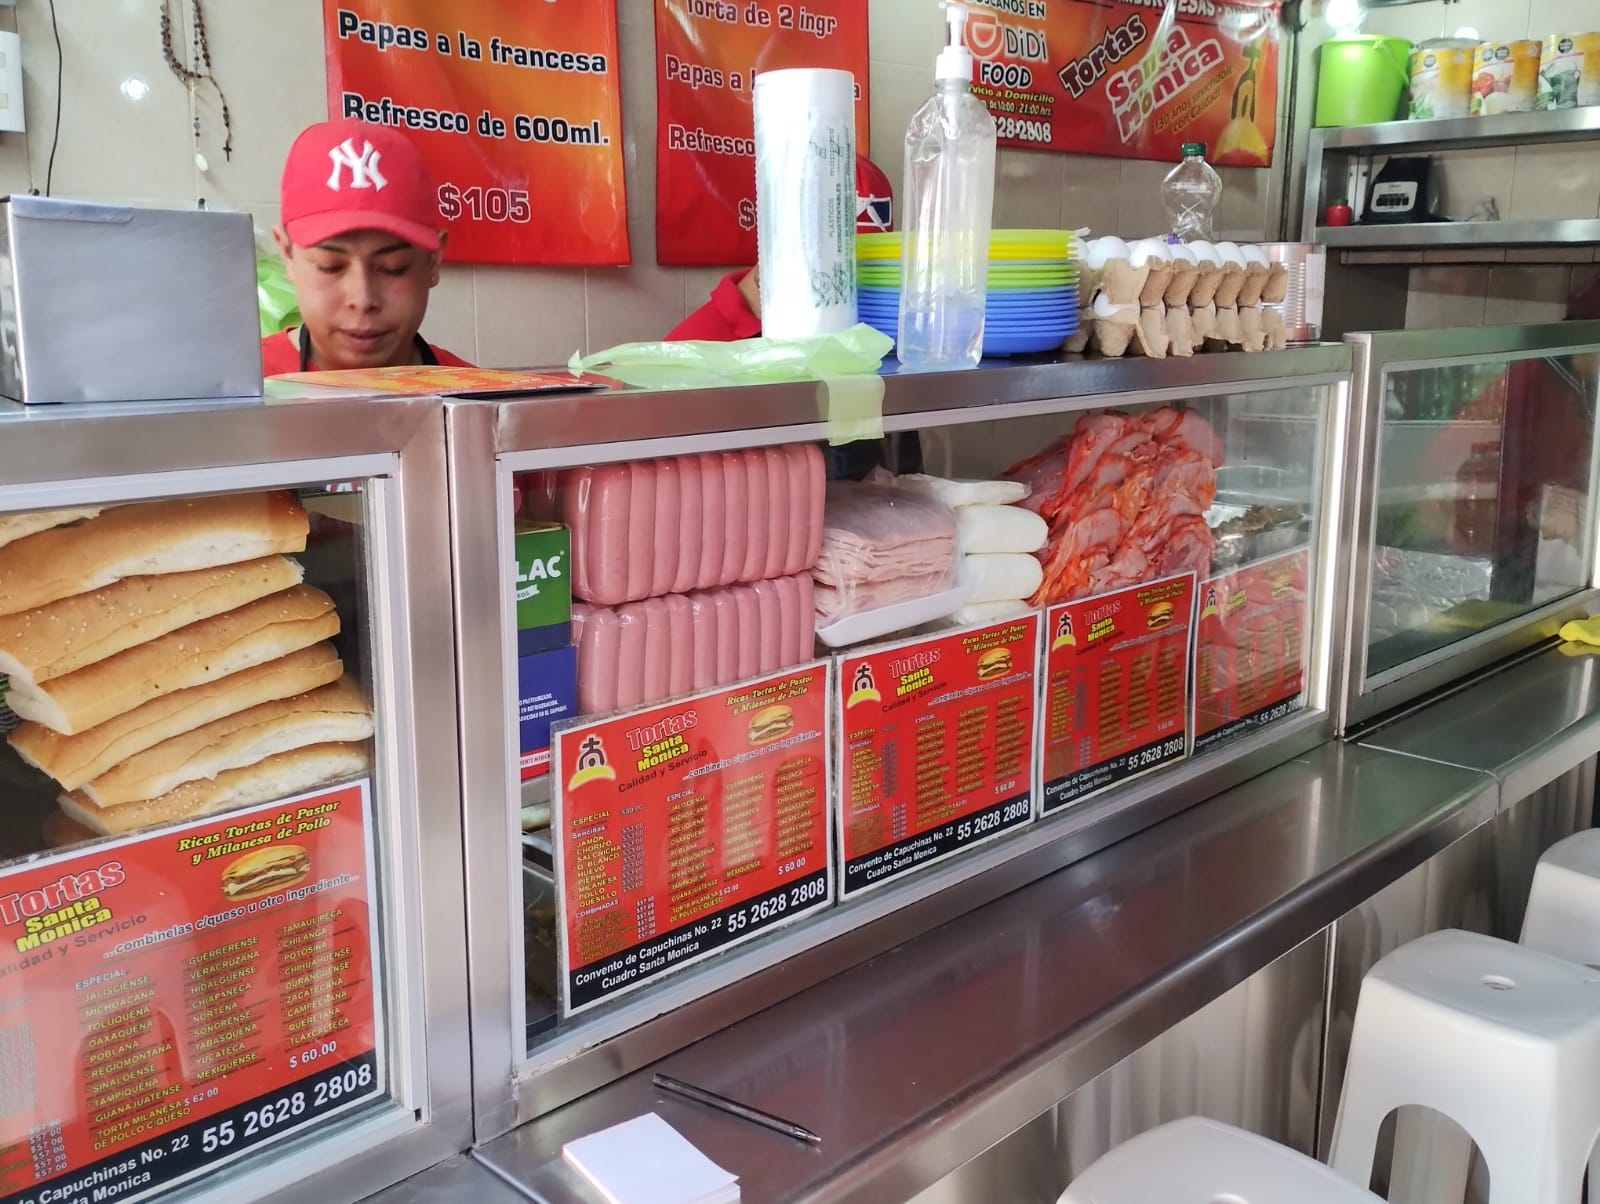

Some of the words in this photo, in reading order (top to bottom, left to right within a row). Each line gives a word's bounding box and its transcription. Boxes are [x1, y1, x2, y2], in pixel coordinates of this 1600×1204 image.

[744, 2, 771, 25] de
[778, 6, 794, 29] 2
[799, 7, 837, 39] ingr
[1028, 2, 1046, 18] EN
[338, 10, 428, 51] Papas
[437, 33, 451, 55] a
[459, 32, 481, 61] la
[490, 38, 607, 73] francesa
[1005, 27, 1048, 63] DiDi
[1058, 14, 1147, 99] Tortas
[665, 54, 723, 90] Papas
[730, 71, 742, 90] a
[981, 62, 1032, 88] FOOD
[1005, 89, 1055, 103] Domicilio
[1019, 103, 1039, 115] 21:00
[343, 92, 469, 133] Refresco
[477, 110, 506, 138] de
[514, 116, 610, 146] 600ml.
[669, 124, 756, 157] Refresco
[326, 137, 389, 192] NY
[438, 183, 531, 223] $105
[1090, 618, 1113, 633] Santa
[888, 647, 941, 678] Tortas
[900, 666, 930, 685] Santa
[727, 692, 752, 707] Ricas
[752, 685, 778, 699] Tortas
[779, 681, 788, 691] de
[778, 693, 787, 703] de
[788, 685, 808, 700] Pollo
[896, 674, 934, 697] Monica
[626, 709, 698, 751] Tortas
[637, 743, 689, 773] Monica
[642, 734, 683, 758] Santa
[1127, 756, 1139, 771] 55
[1141, 745, 1162, 766] 2628
[1164, 737, 1184, 756] 2808
[618, 770, 658, 793] Calidad
[660, 766, 667, 778] y
[668, 748, 708, 773] Servicio
[667, 788, 695, 802] ESPECIAL
[176, 829, 220, 853] Ricas
[224, 816, 273, 839] Tortas
[275, 811, 292, 826] de
[296, 799, 340, 821] Pastor
[572, 811, 611, 826] ESPECIAL
[572, 824, 606, 839] Sencillas
[191, 850, 202, 867] y
[205, 831, 272, 860] Milanesa
[275, 825, 292, 841] de
[295, 814, 331, 835] Pollo
[577, 840, 612, 855] CHORIZO
[848, 855, 883, 875] Convento
[884, 851, 893, 861] de
[893, 836, 933, 858] Capuchinas
[934, 830, 945, 843] No.
[946, 826, 954, 839] 22
[957, 822, 972, 841] 55
[974, 809, 1001, 833] 2628
[1003, 799, 1029, 823] 2808
[577, 846, 621, 863] SALCHICHA
[778, 866, 784, 876] $
[784, 857, 806, 872] 60.00
[866, 862, 892, 880] Cuadro
[893, 855, 912, 870] Santa
[913, 846, 937, 865] Monica
[577, 865, 605, 878] HUEVO
[579, 876, 618, 892] MILANESA
[0, 861, 126, 925] Tortas
[579, 887, 605, 900] POLLO
[579, 891, 617, 908] QUESILLO
[25, 897, 101, 933] Santa
[196, 906, 246, 930] c/queso
[248, 902, 256, 913] u
[259, 893, 284, 911] otro
[283, 909, 342, 932] TAMAULIPECA
[576, 899, 619, 919] COMBINADAS
[15, 908, 112, 953] Monica
[58, 943, 68, 957] y
[75, 911, 147, 948] Servicio
[283, 927, 327, 947] CHILANGA
[576, 961, 623, 986] Convento
[625, 953, 637, 965] de
[639, 932, 693, 960] Capuchinas
[695, 924, 710, 936] No.
[711, 917, 722, 929] 22
[728, 912, 747, 933] 55
[750, 895, 787, 923] 2628
[791, 878, 825, 905] 2808
[188, 937, 257, 963] GUERRERENSE
[284, 941, 327, 961] POTOSINA
[284, 947, 351, 974] CHIHUAHUENSE
[190, 951, 259, 978] VERACRUZANA
[285, 961, 350, 988] DURANGUENSE
[601, 968, 638, 990] Cuadro
[639, 956, 665, 975] Santa
[666, 941, 700, 962] Monica
[75, 968, 128, 990] ESPECIAL
[83, 975, 149, 1001] JALISCIENSE
[191, 966, 256, 992] HIDALGUENSE
[286, 977, 343, 1002] ZACATECANA
[85, 989, 154, 1016] MICHOACANA
[192, 982, 251, 1007] CHIAPANECA
[287, 989, 347, 1016] CAMPECHANA
[193, 1011, 251, 1036] SONORENSE
[288, 1006, 340, 1030] QUERETANA
[290, 1018, 349, 1045] TLAXCALTECA
[89, 1041, 138, 1062] POBLANA
[90, 1044, 171, 1077] REGIOMONTANA
[195, 1042, 246, 1066] YUCATECA
[290, 1055, 297, 1070] $
[301, 1038, 337, 1065] 60.00
[92, 1064, 156, 1092] SINALOENSE
[196, 1052, 257, 1080] MEXIQUENSE
[95, 1085, 181, 1121] GUANAJUATENSE
[97, 1119, 127, 1140] TORTA
[130, 1097, 181, 1126] MILANESA
[40, 1157, 137, 1202] Capuchinas
[141, 1146, 168, 1164] No.
[171, 1134, 190, 1151] 22
[202, 1119, 235, 1153] 55
[243, 1091, 306, 1134] 2628
[313, 1063, 372, 1098] 2808
[93, 1137, 108, 1152] DE
[111, 1121, 146, 1144] POLLO
[93, 1171, 151, 1204] Monica
